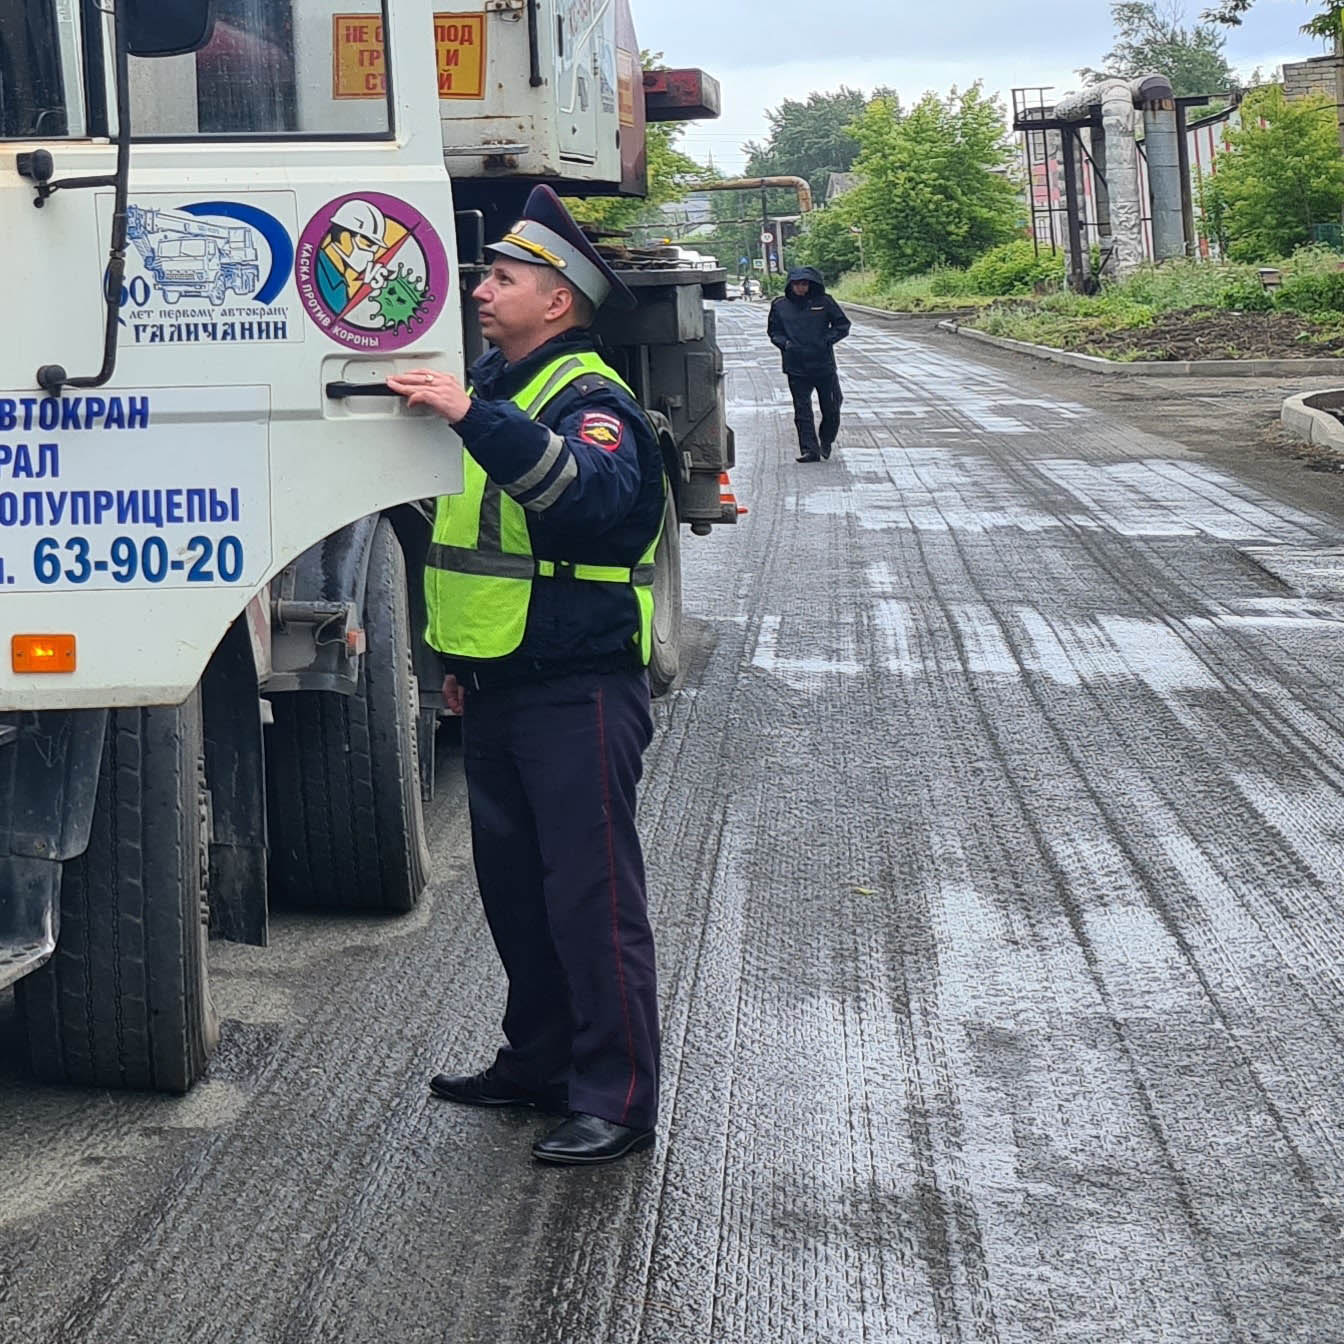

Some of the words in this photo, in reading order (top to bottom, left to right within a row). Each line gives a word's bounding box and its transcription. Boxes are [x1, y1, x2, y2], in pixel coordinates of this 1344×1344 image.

[345, 25, 369, 43] НЕ
[298, 242, 313, 282] КАСКА
[301, 283, 332, 327] ПРОТИВ
[133, 321, 288, 344] ГАЛИЧАНИН
[332, 325, 380, 347] КОРОНЫ
[33, 534, 244, 584] 63-90-20
